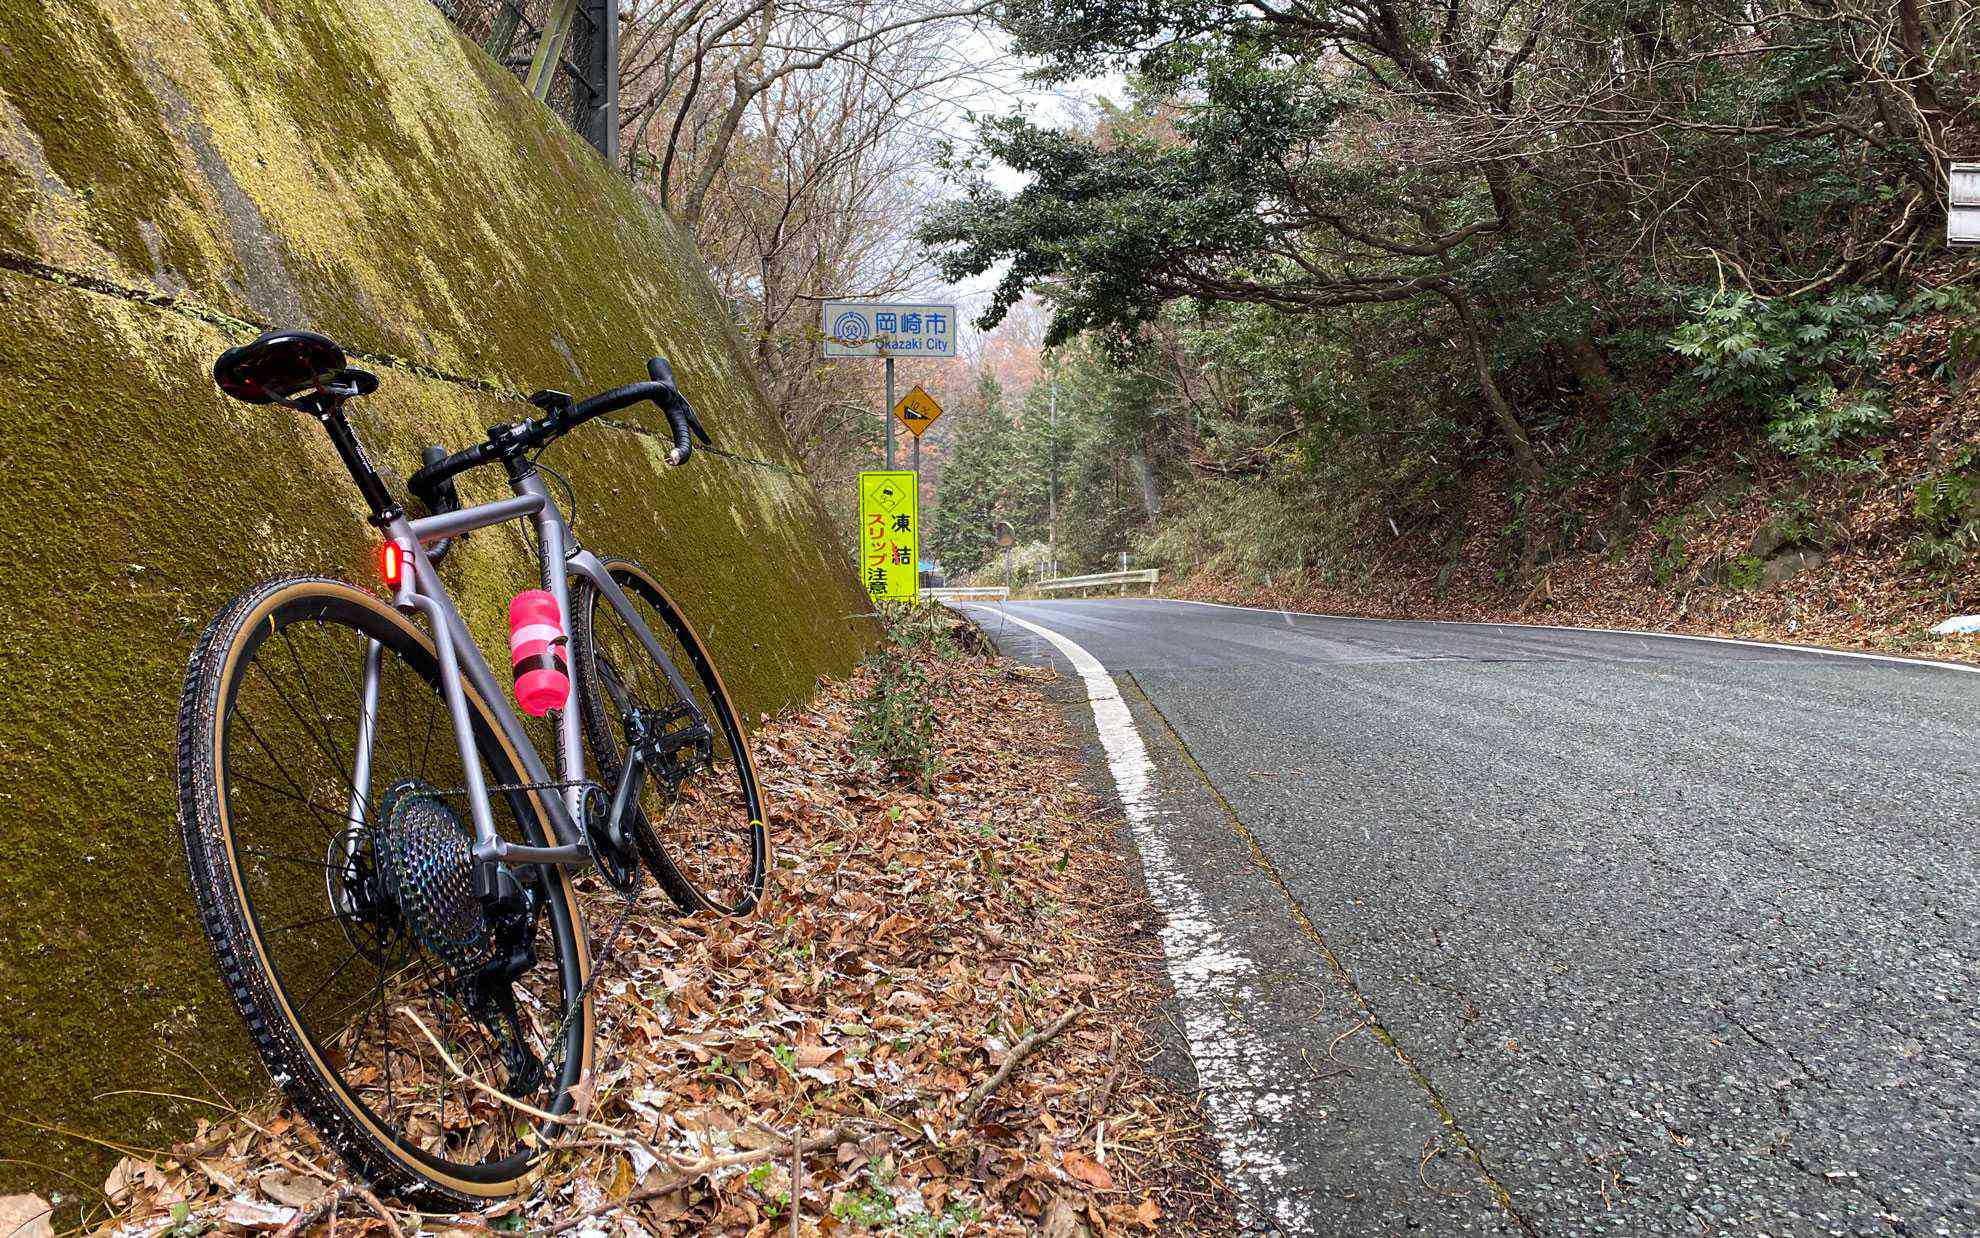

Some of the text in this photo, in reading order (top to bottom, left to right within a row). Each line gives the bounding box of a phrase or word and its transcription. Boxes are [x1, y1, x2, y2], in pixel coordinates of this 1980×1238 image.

[875, 312, 947, 335] 岡崎市
[875, 338, 948, 352] Okazaki City
